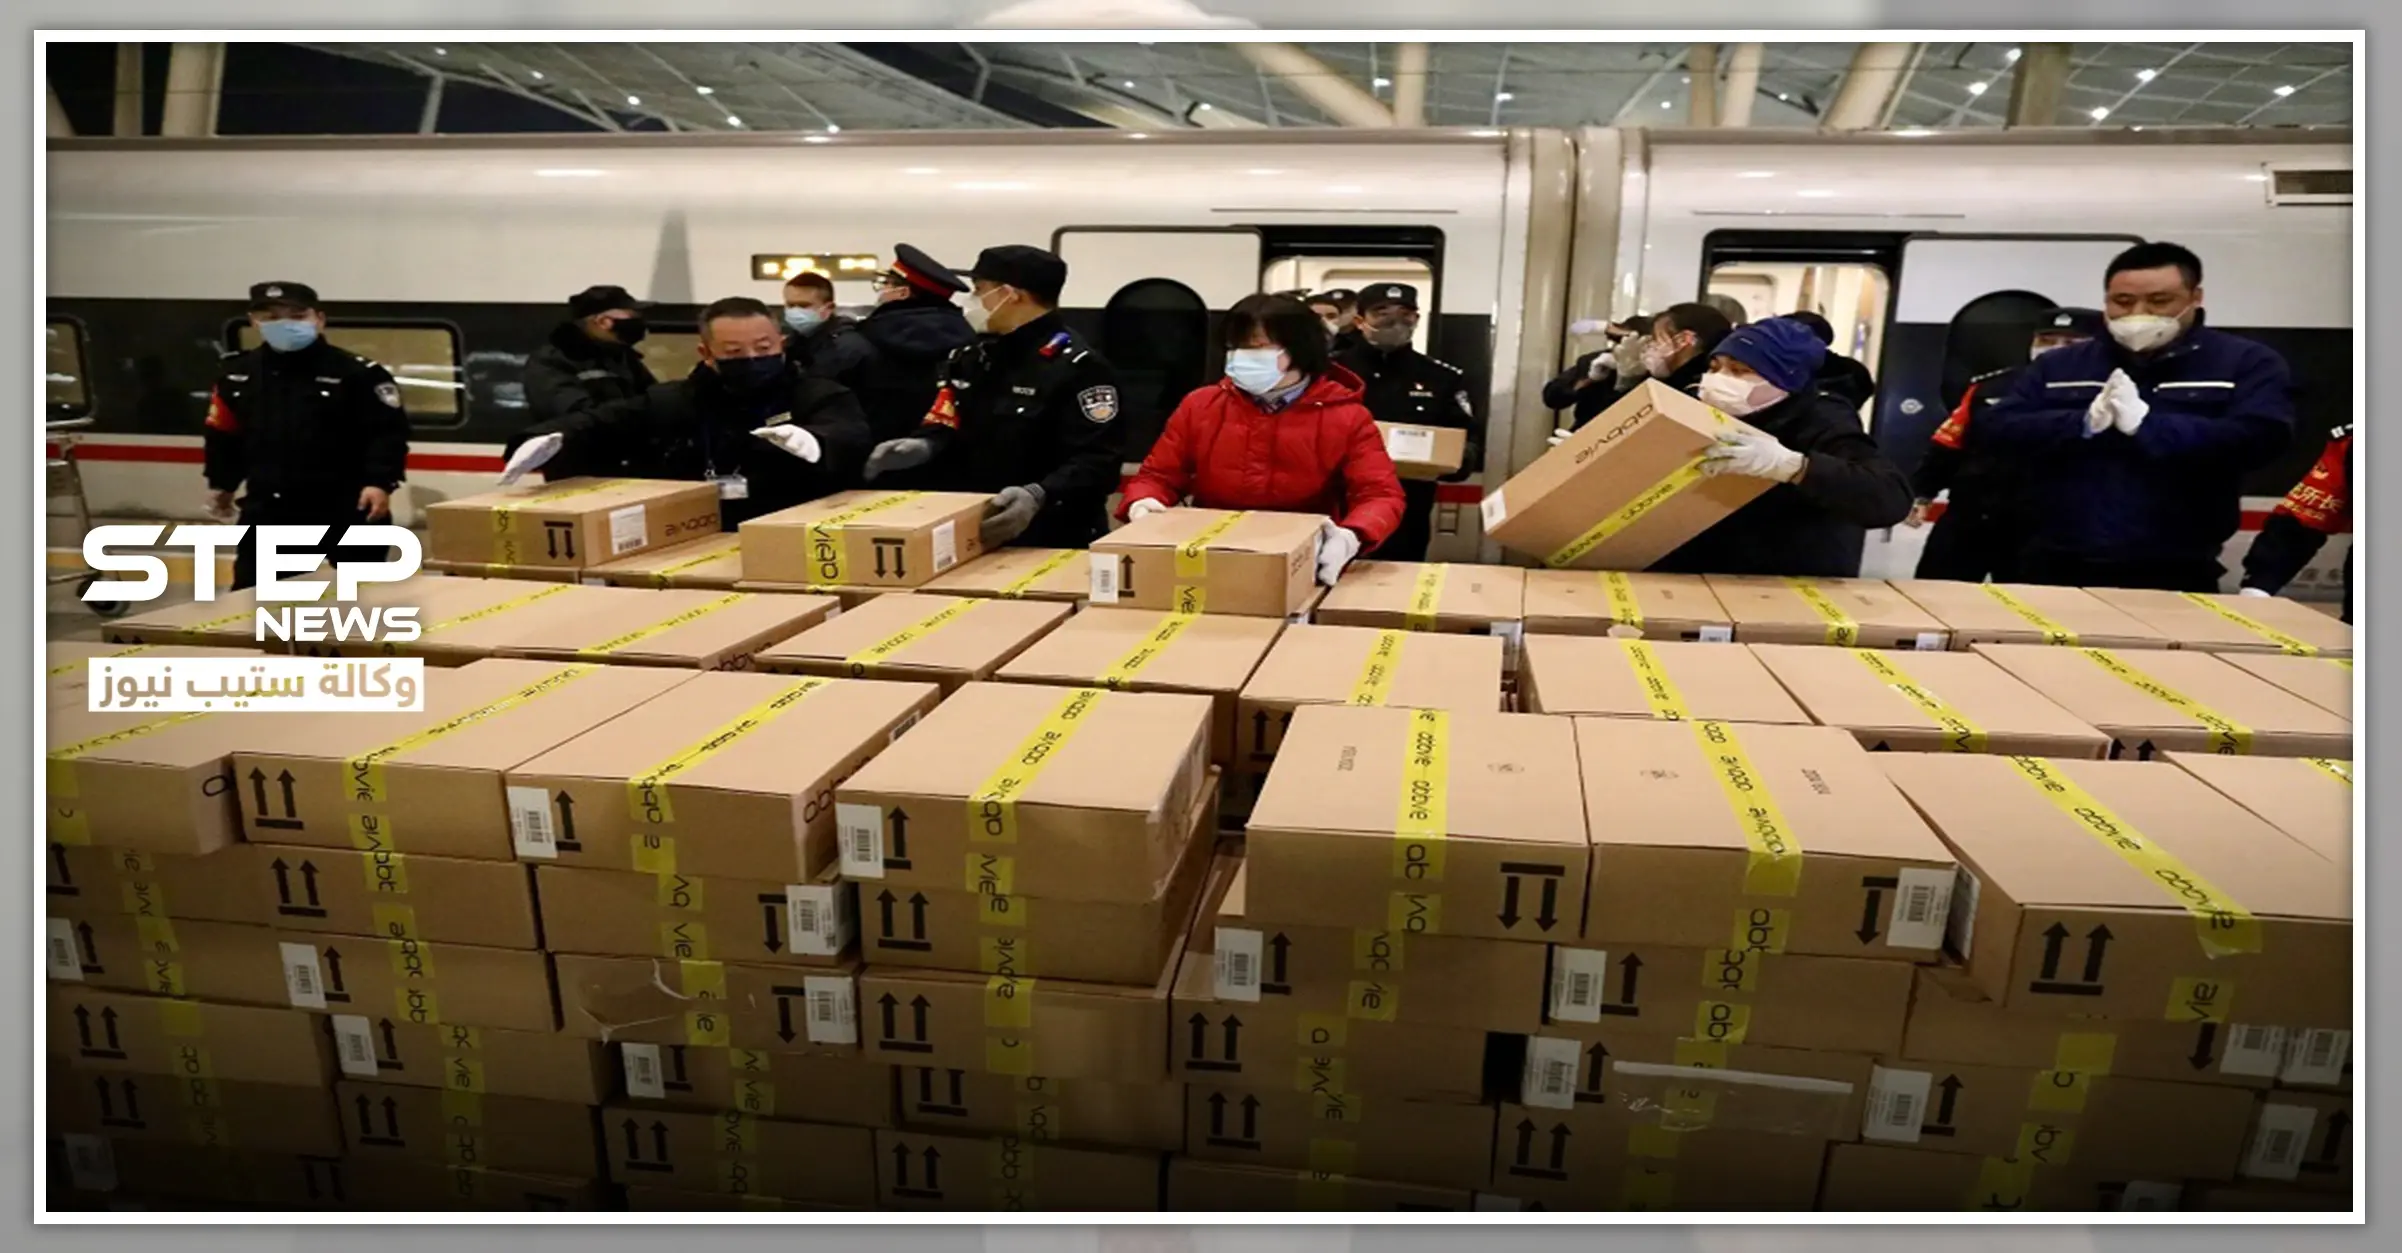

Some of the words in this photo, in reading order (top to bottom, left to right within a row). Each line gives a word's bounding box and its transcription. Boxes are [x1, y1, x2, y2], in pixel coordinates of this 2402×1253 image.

[1574, 404, 1653, 464] abbvie
[1022, 731, 1062, 765] abbvie
[1409, 780, 1434, 820] abbvie
[2074, 807, 2142, 850] abbvie
